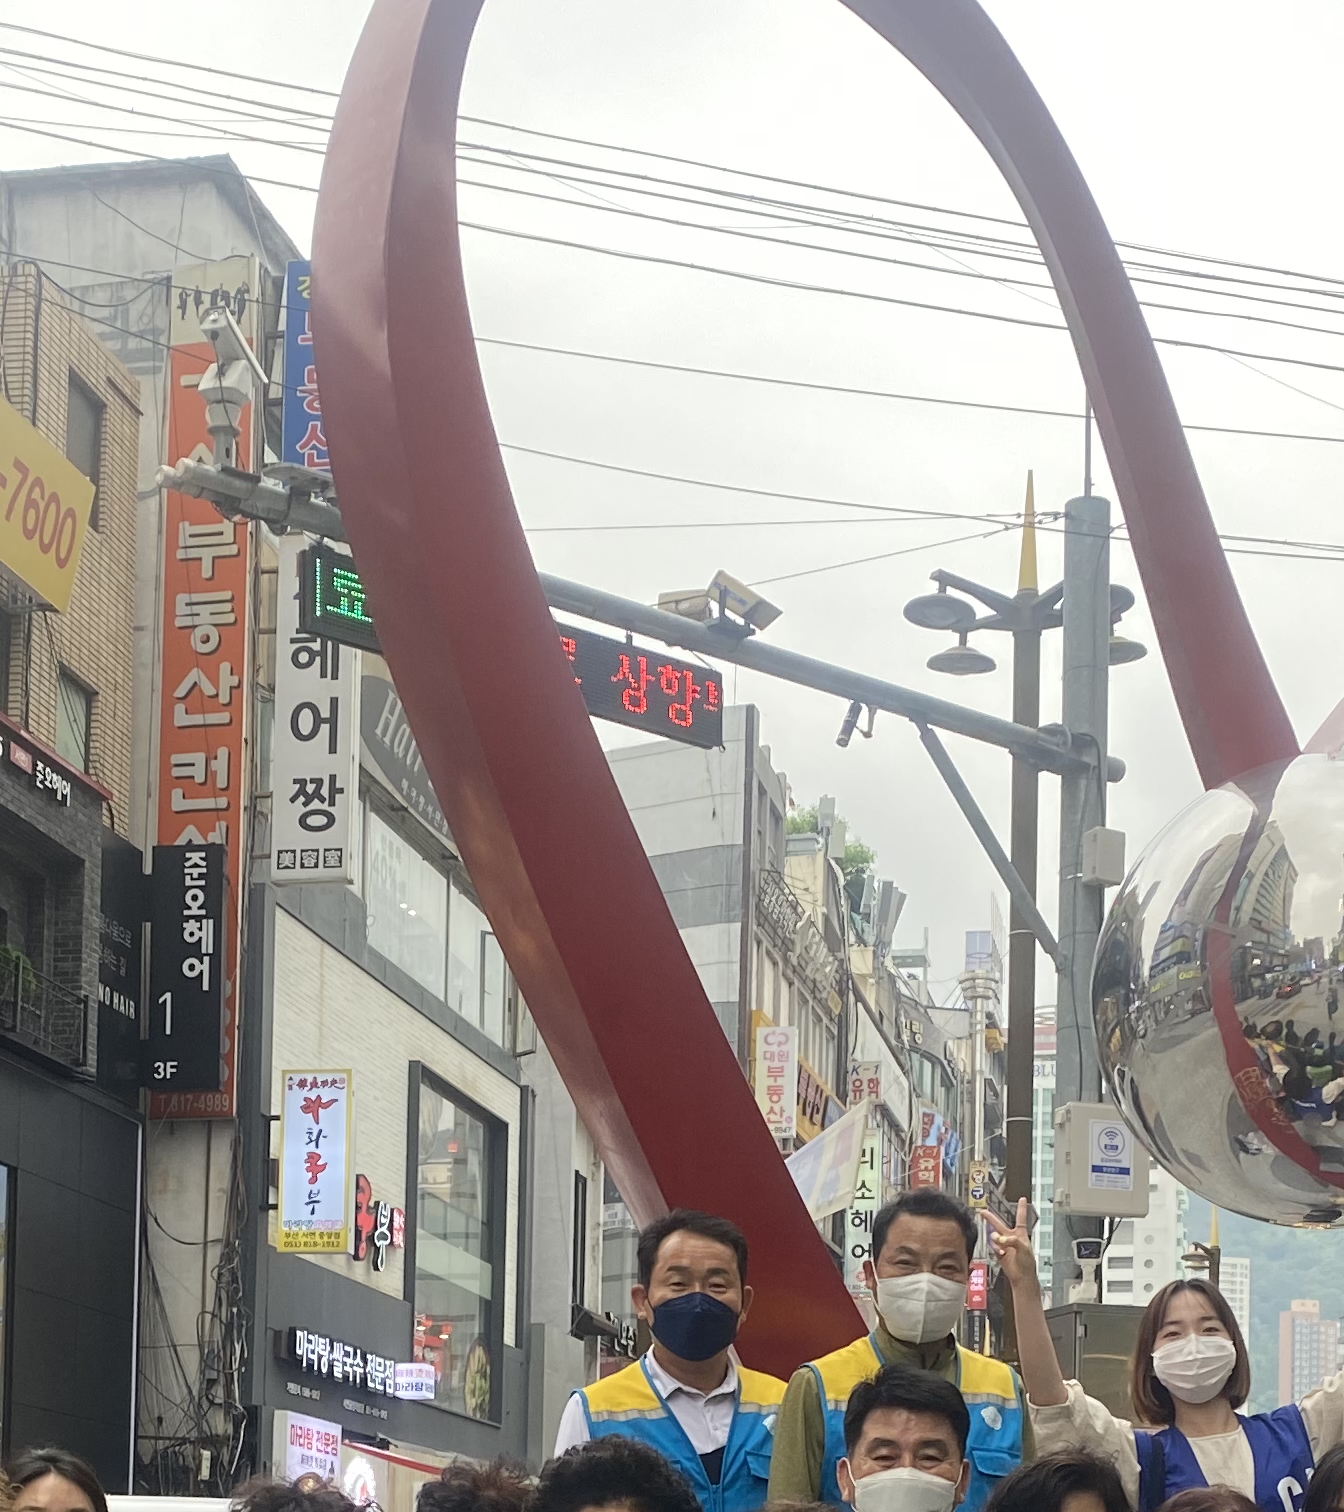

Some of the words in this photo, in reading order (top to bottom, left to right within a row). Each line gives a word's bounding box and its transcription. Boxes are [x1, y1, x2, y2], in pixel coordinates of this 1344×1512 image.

[36, 759, 71, 808] 준오헤어
[278, 848, 343, 869] 美容室
[181, 851, 214, 992] 준오헤어
[113, 989, 135, 1020] HAIR
[153, 1061, 179, 1080] 3F
[765, 1065, 786, 1126] 부동산
[365, 1353, 395, 1395] 전문점
[395, 1381, 424, 1392] 마라탕
[290, 1423, 313, 1451] 마라탕
[315, 1430, 338, 1457] 전문점
